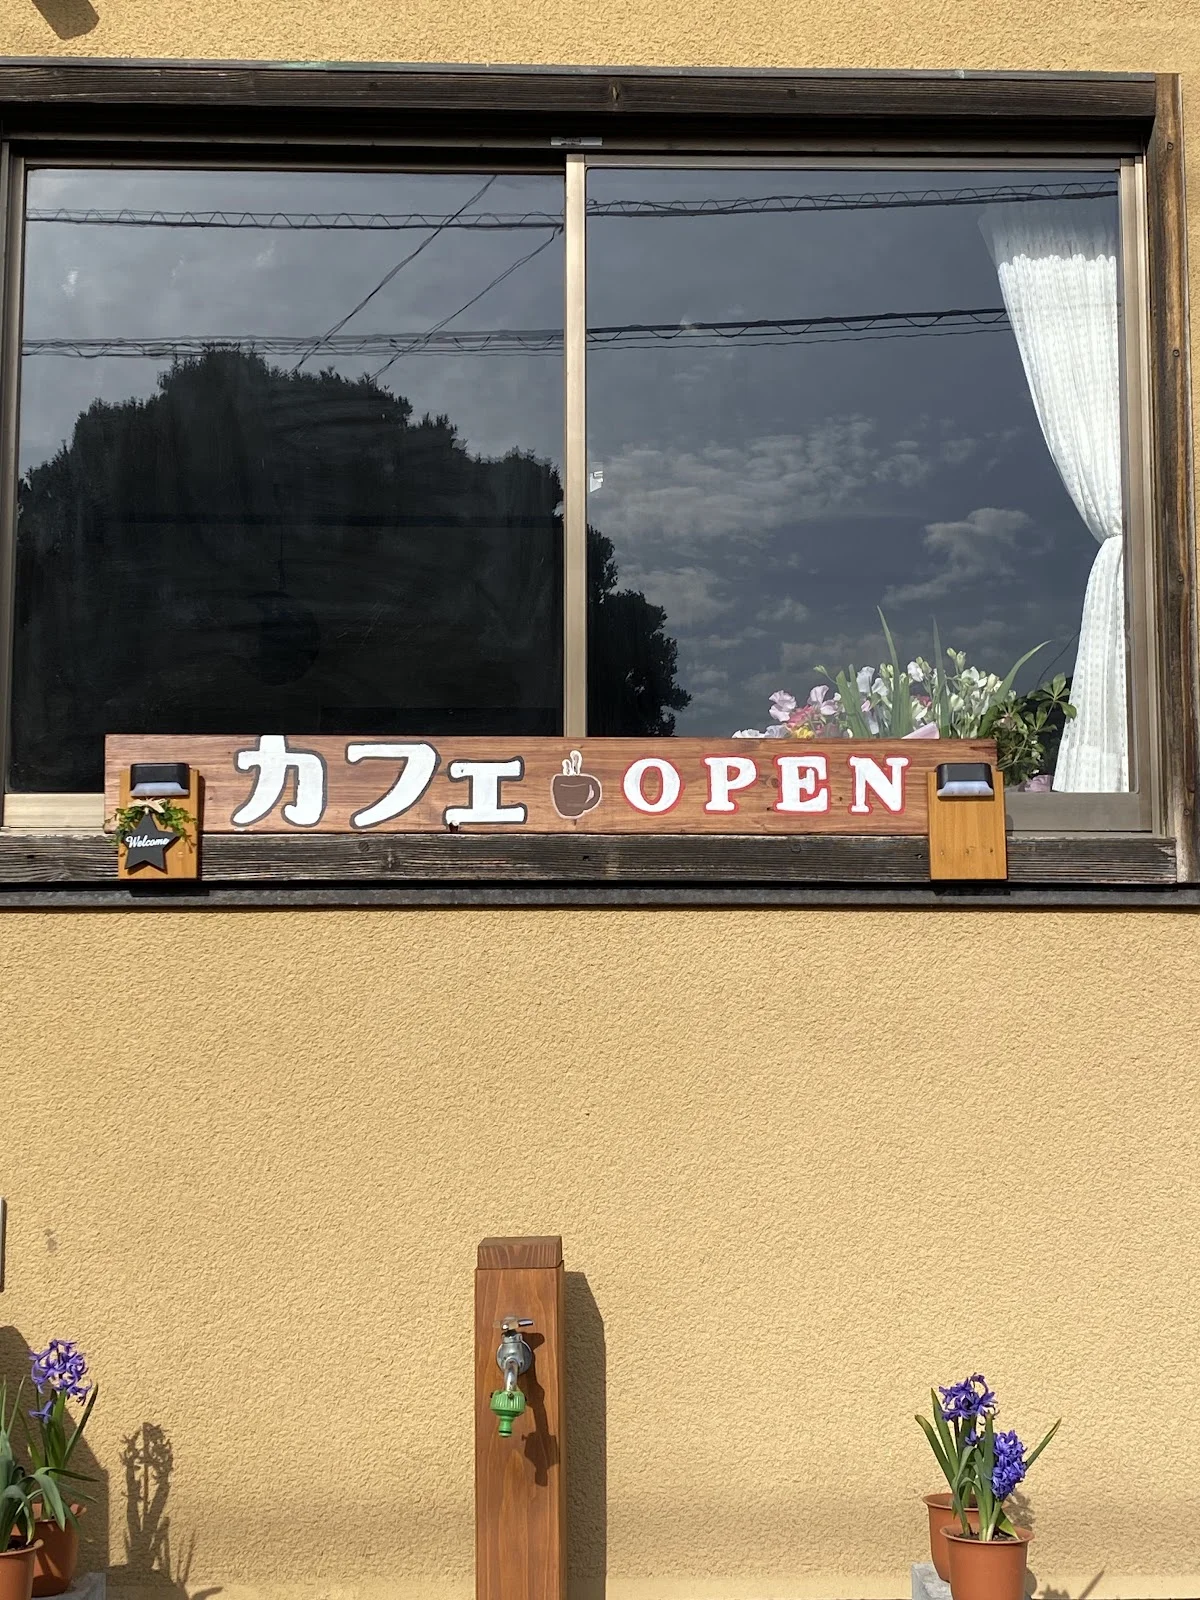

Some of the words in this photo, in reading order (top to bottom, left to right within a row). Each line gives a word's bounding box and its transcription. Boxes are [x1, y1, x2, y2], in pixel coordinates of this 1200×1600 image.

[231, 734, 528, 829] カフェ
[621, 753, 911, 816] OPEN
[125, 834, 170, 848] Welcome
